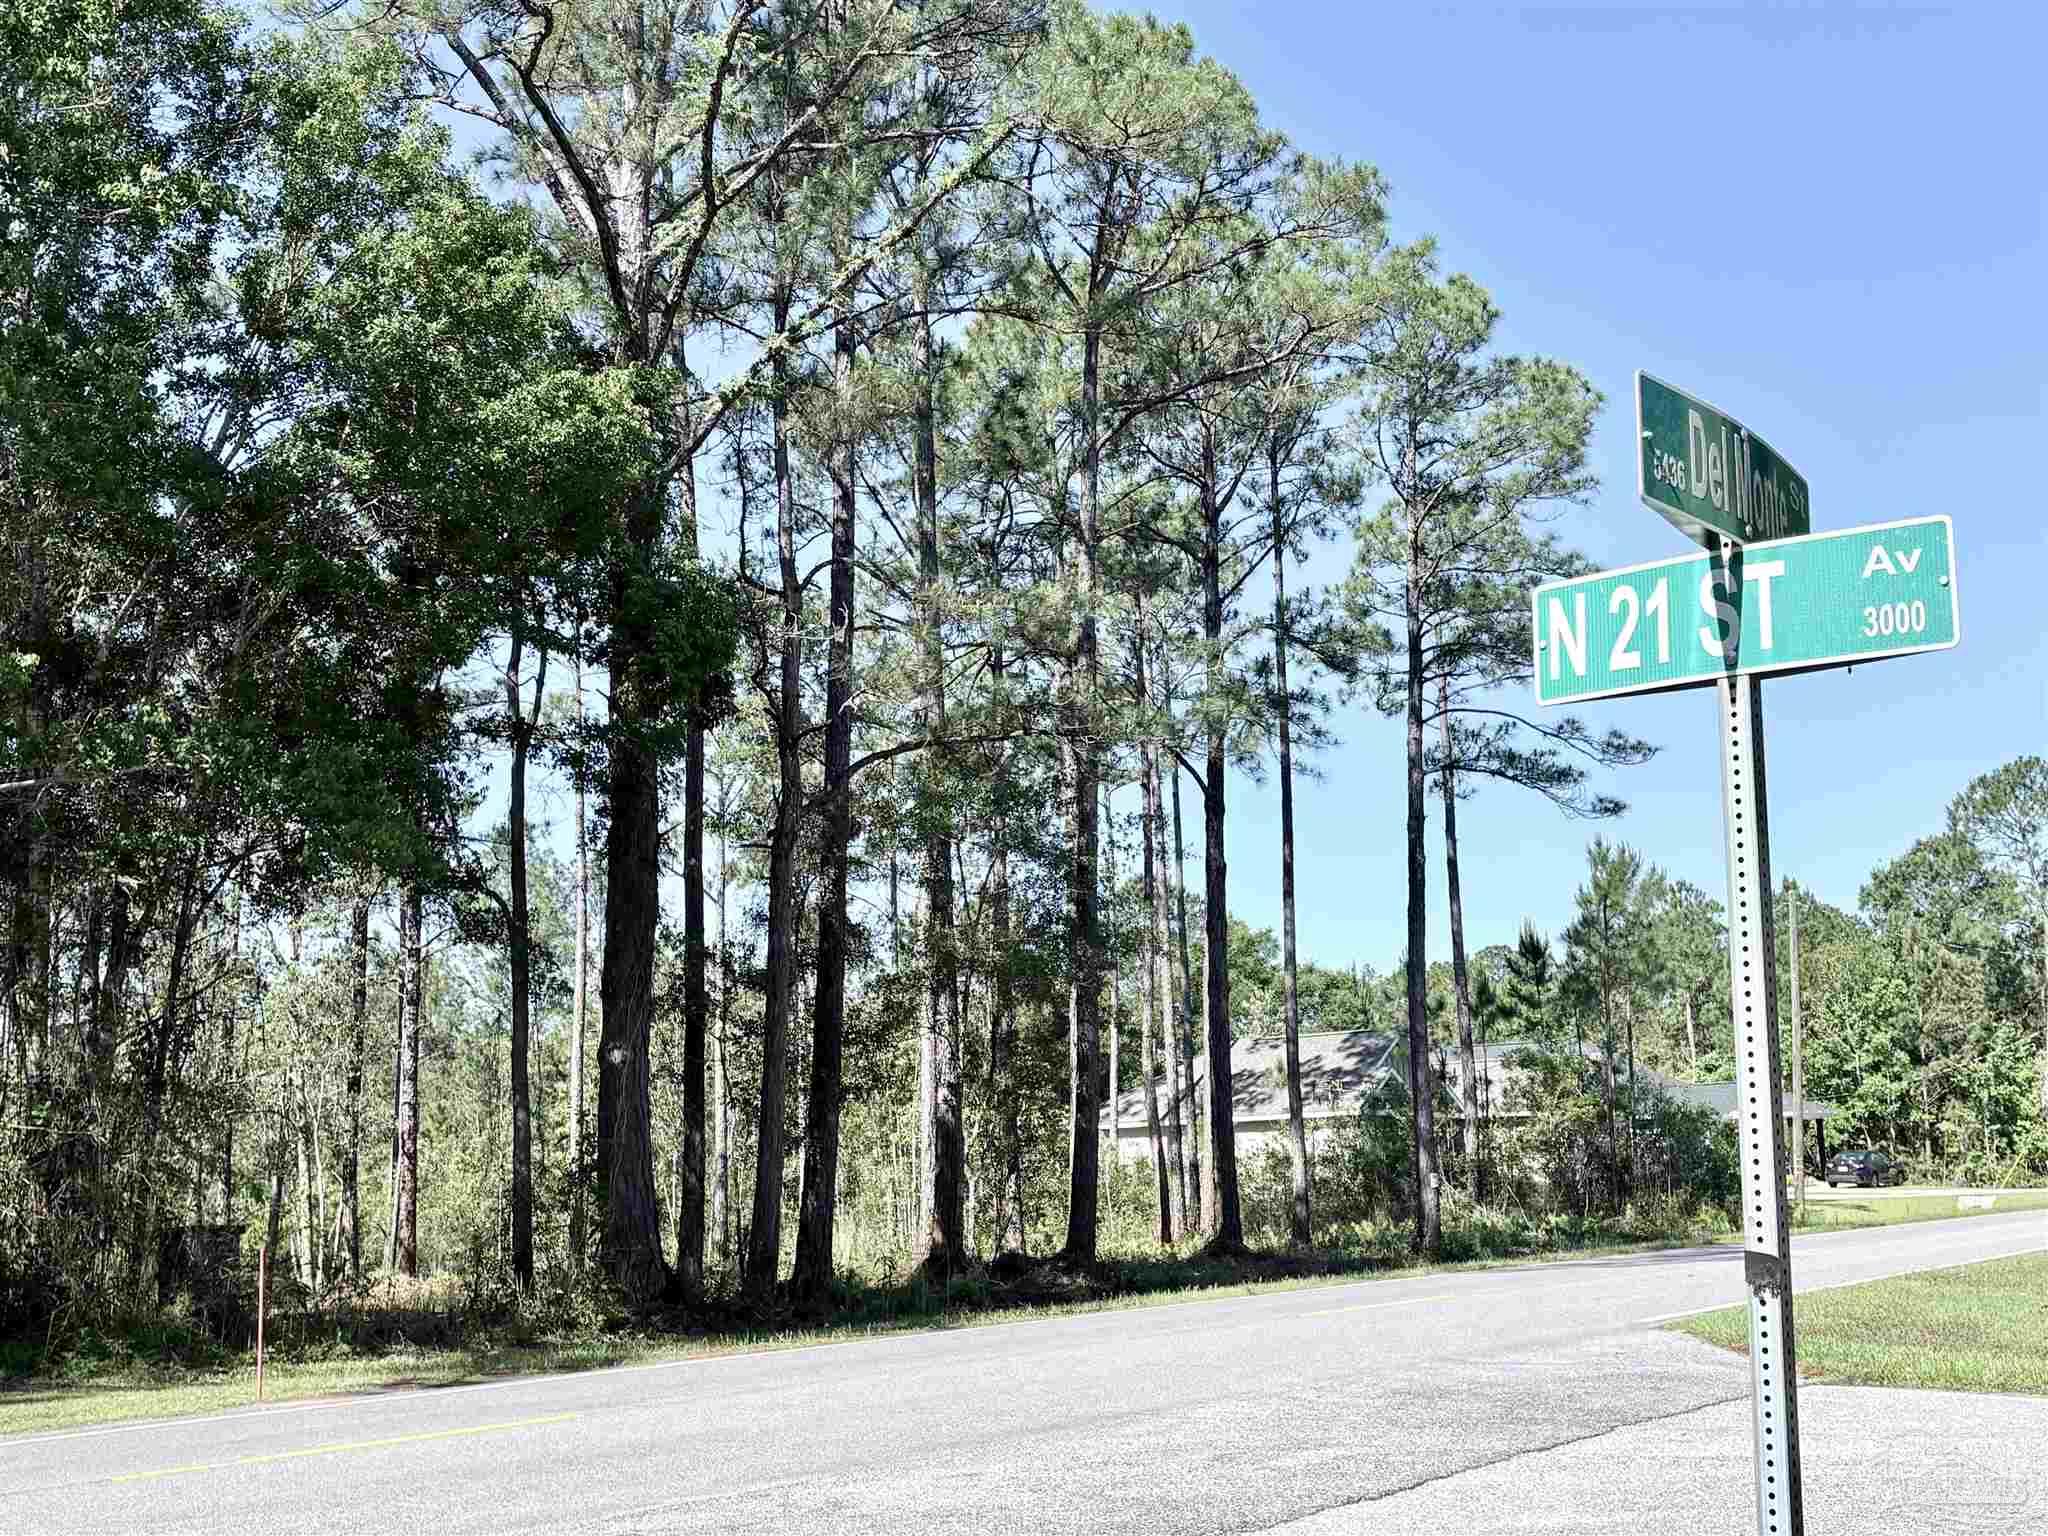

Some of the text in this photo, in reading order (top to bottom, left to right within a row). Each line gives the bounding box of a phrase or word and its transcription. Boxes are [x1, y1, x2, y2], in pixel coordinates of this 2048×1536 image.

[1688, 408, 1807, 540] Del Monte St
[1547, 545, 1923, 681] N 21 ST Av
[1862, 601, 1927, 638] 3000
